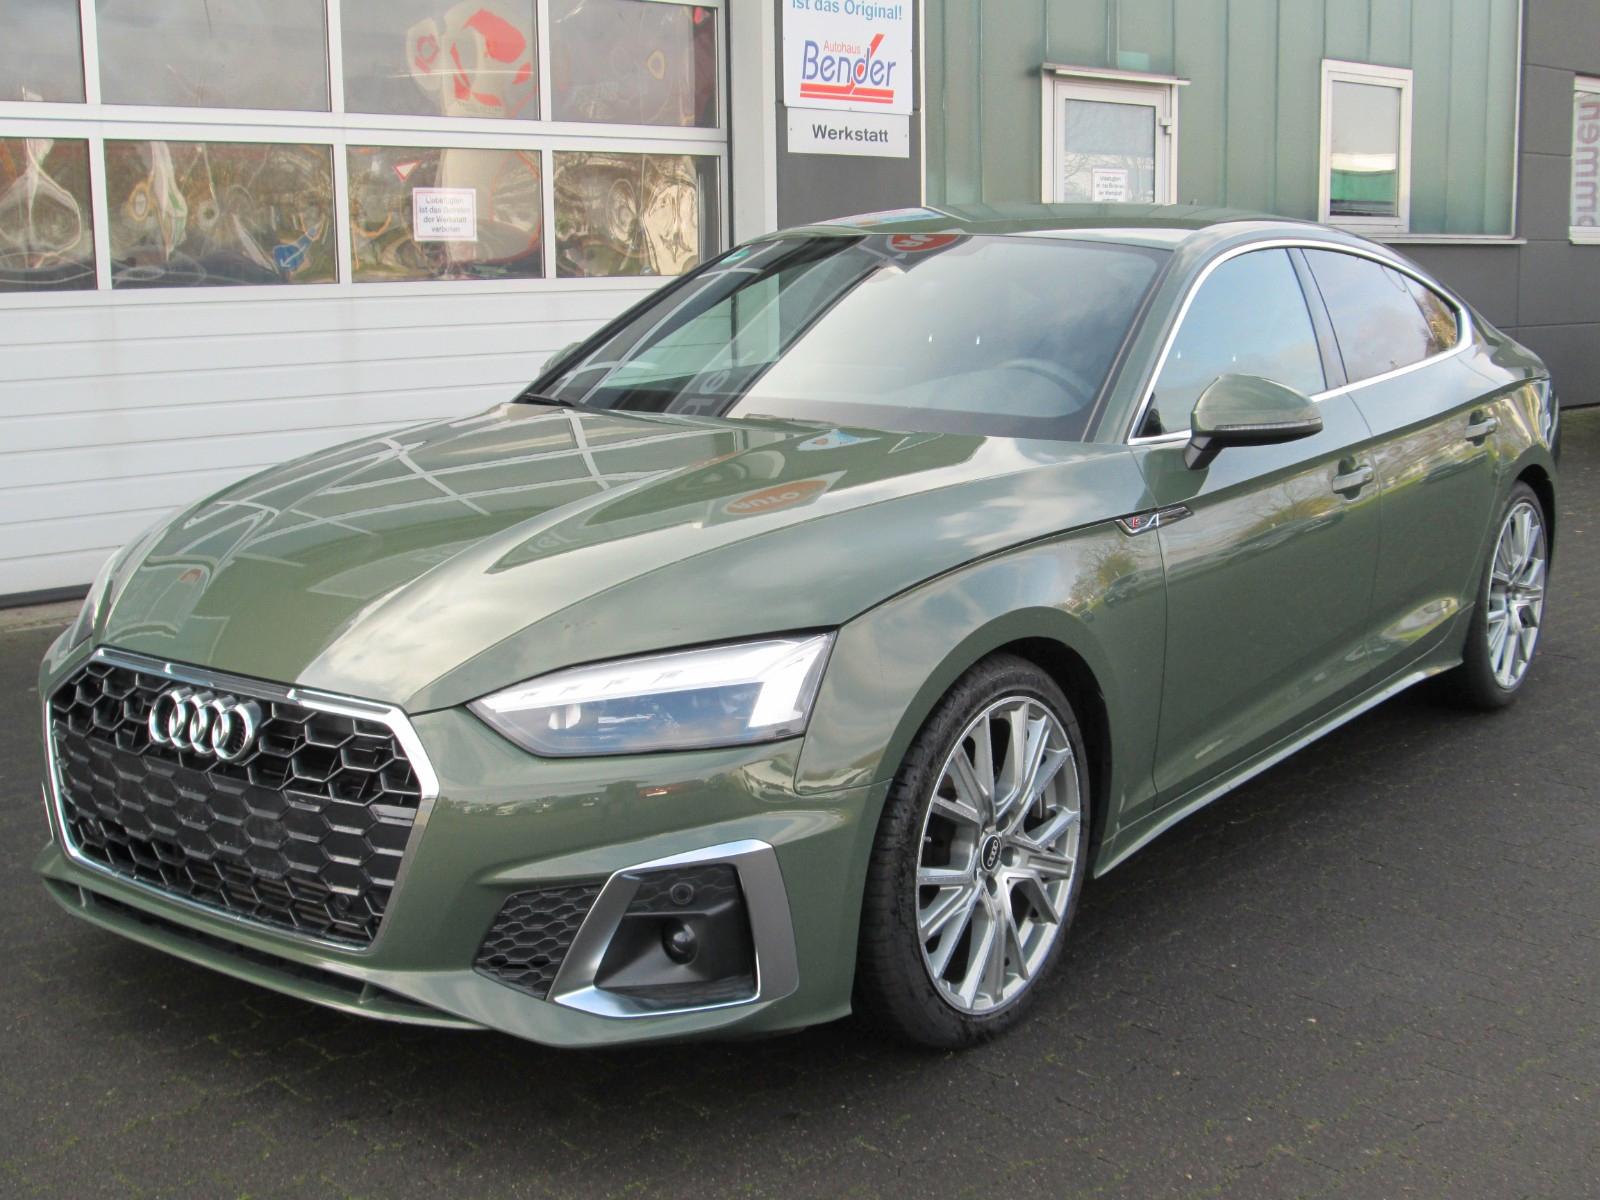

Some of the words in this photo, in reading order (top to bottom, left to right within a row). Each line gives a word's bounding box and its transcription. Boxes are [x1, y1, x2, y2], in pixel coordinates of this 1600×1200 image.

[814, 0, 840, 13] das
[844, 0, 902, 20] Original!
[823, 40, 861, 55] Autohaus
[802, 40, 896, 86] Bender
[812, 123, 889, 143] Werkstatt
